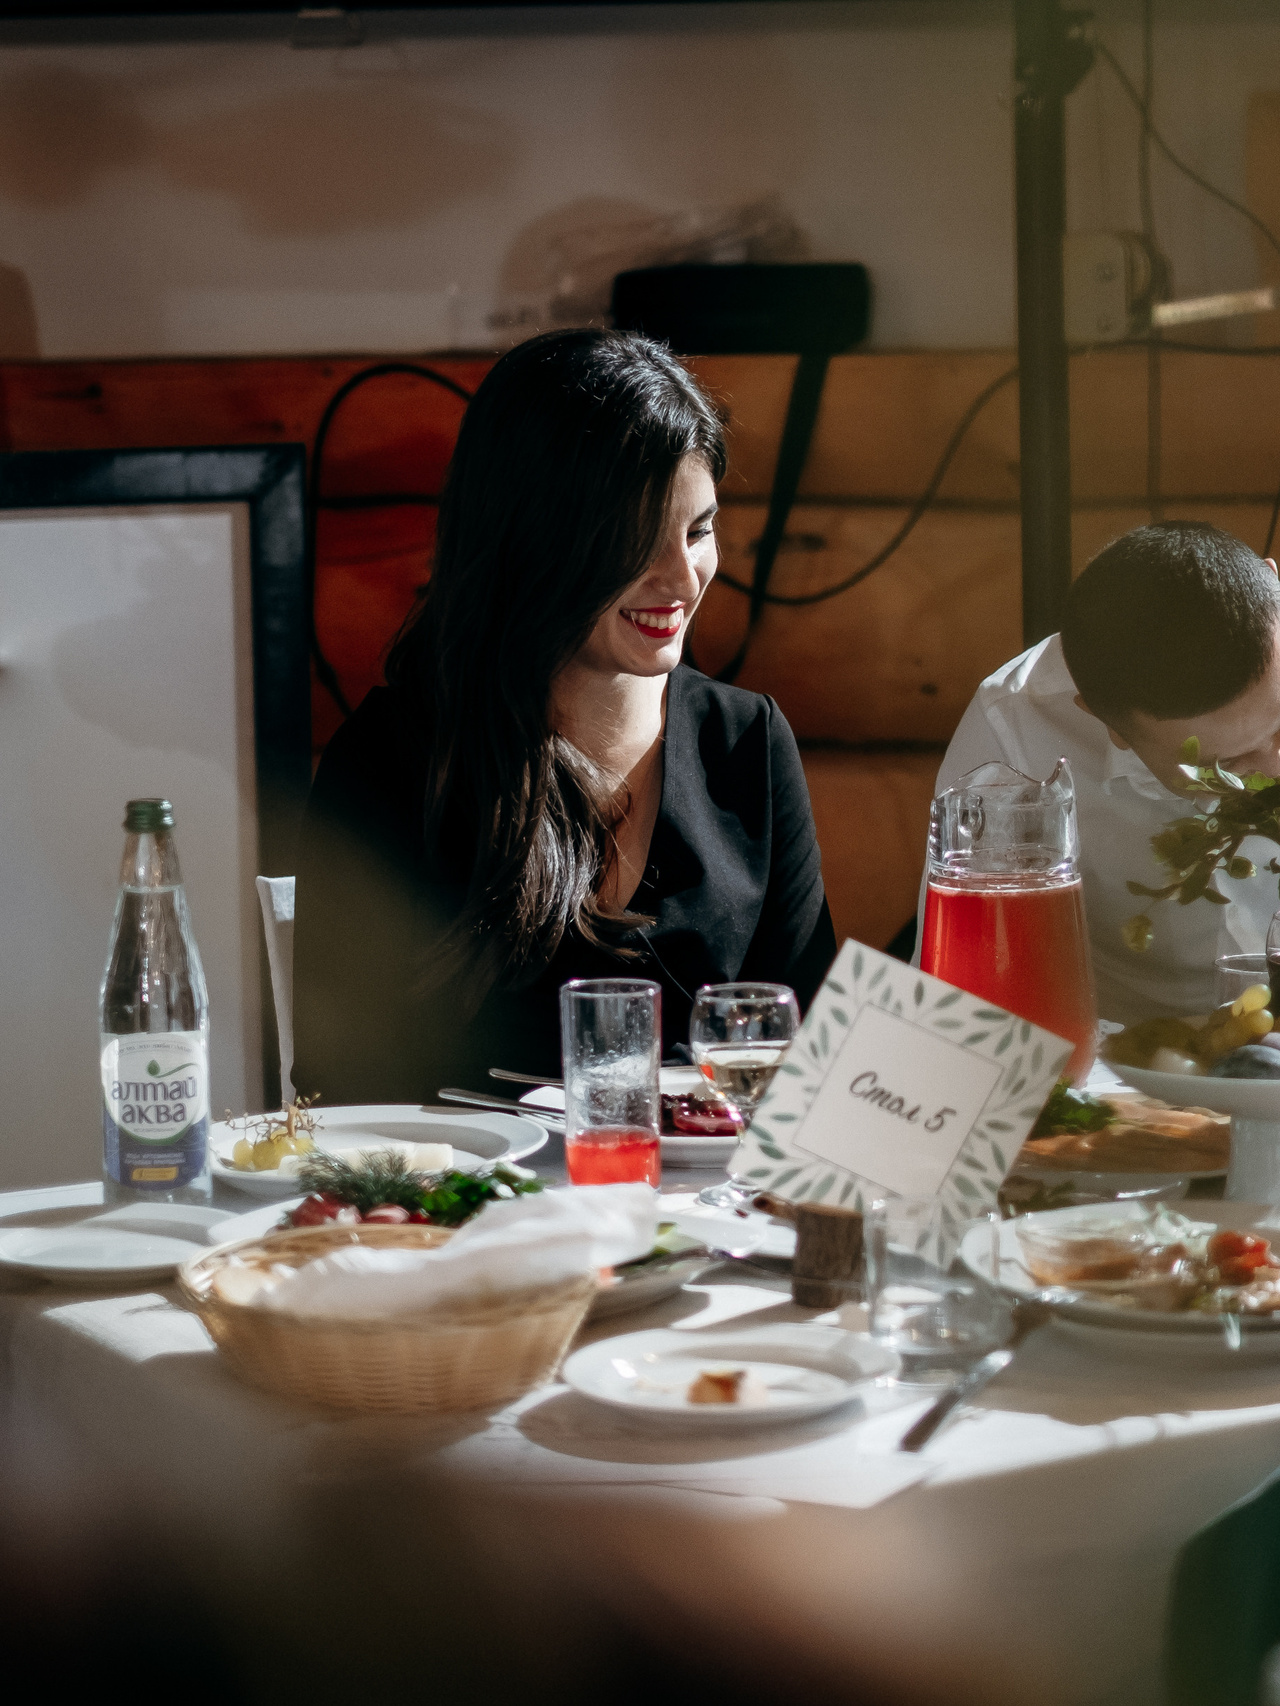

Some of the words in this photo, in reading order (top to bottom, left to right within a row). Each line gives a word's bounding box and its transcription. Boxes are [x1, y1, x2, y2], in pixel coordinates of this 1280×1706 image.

[112, 1076, 197, 1102] алтай
[849, 1070, 921, 1124] Стол
[924, 1106, 958, 1133] 5
[121, 1103, 186, 1124] аква
